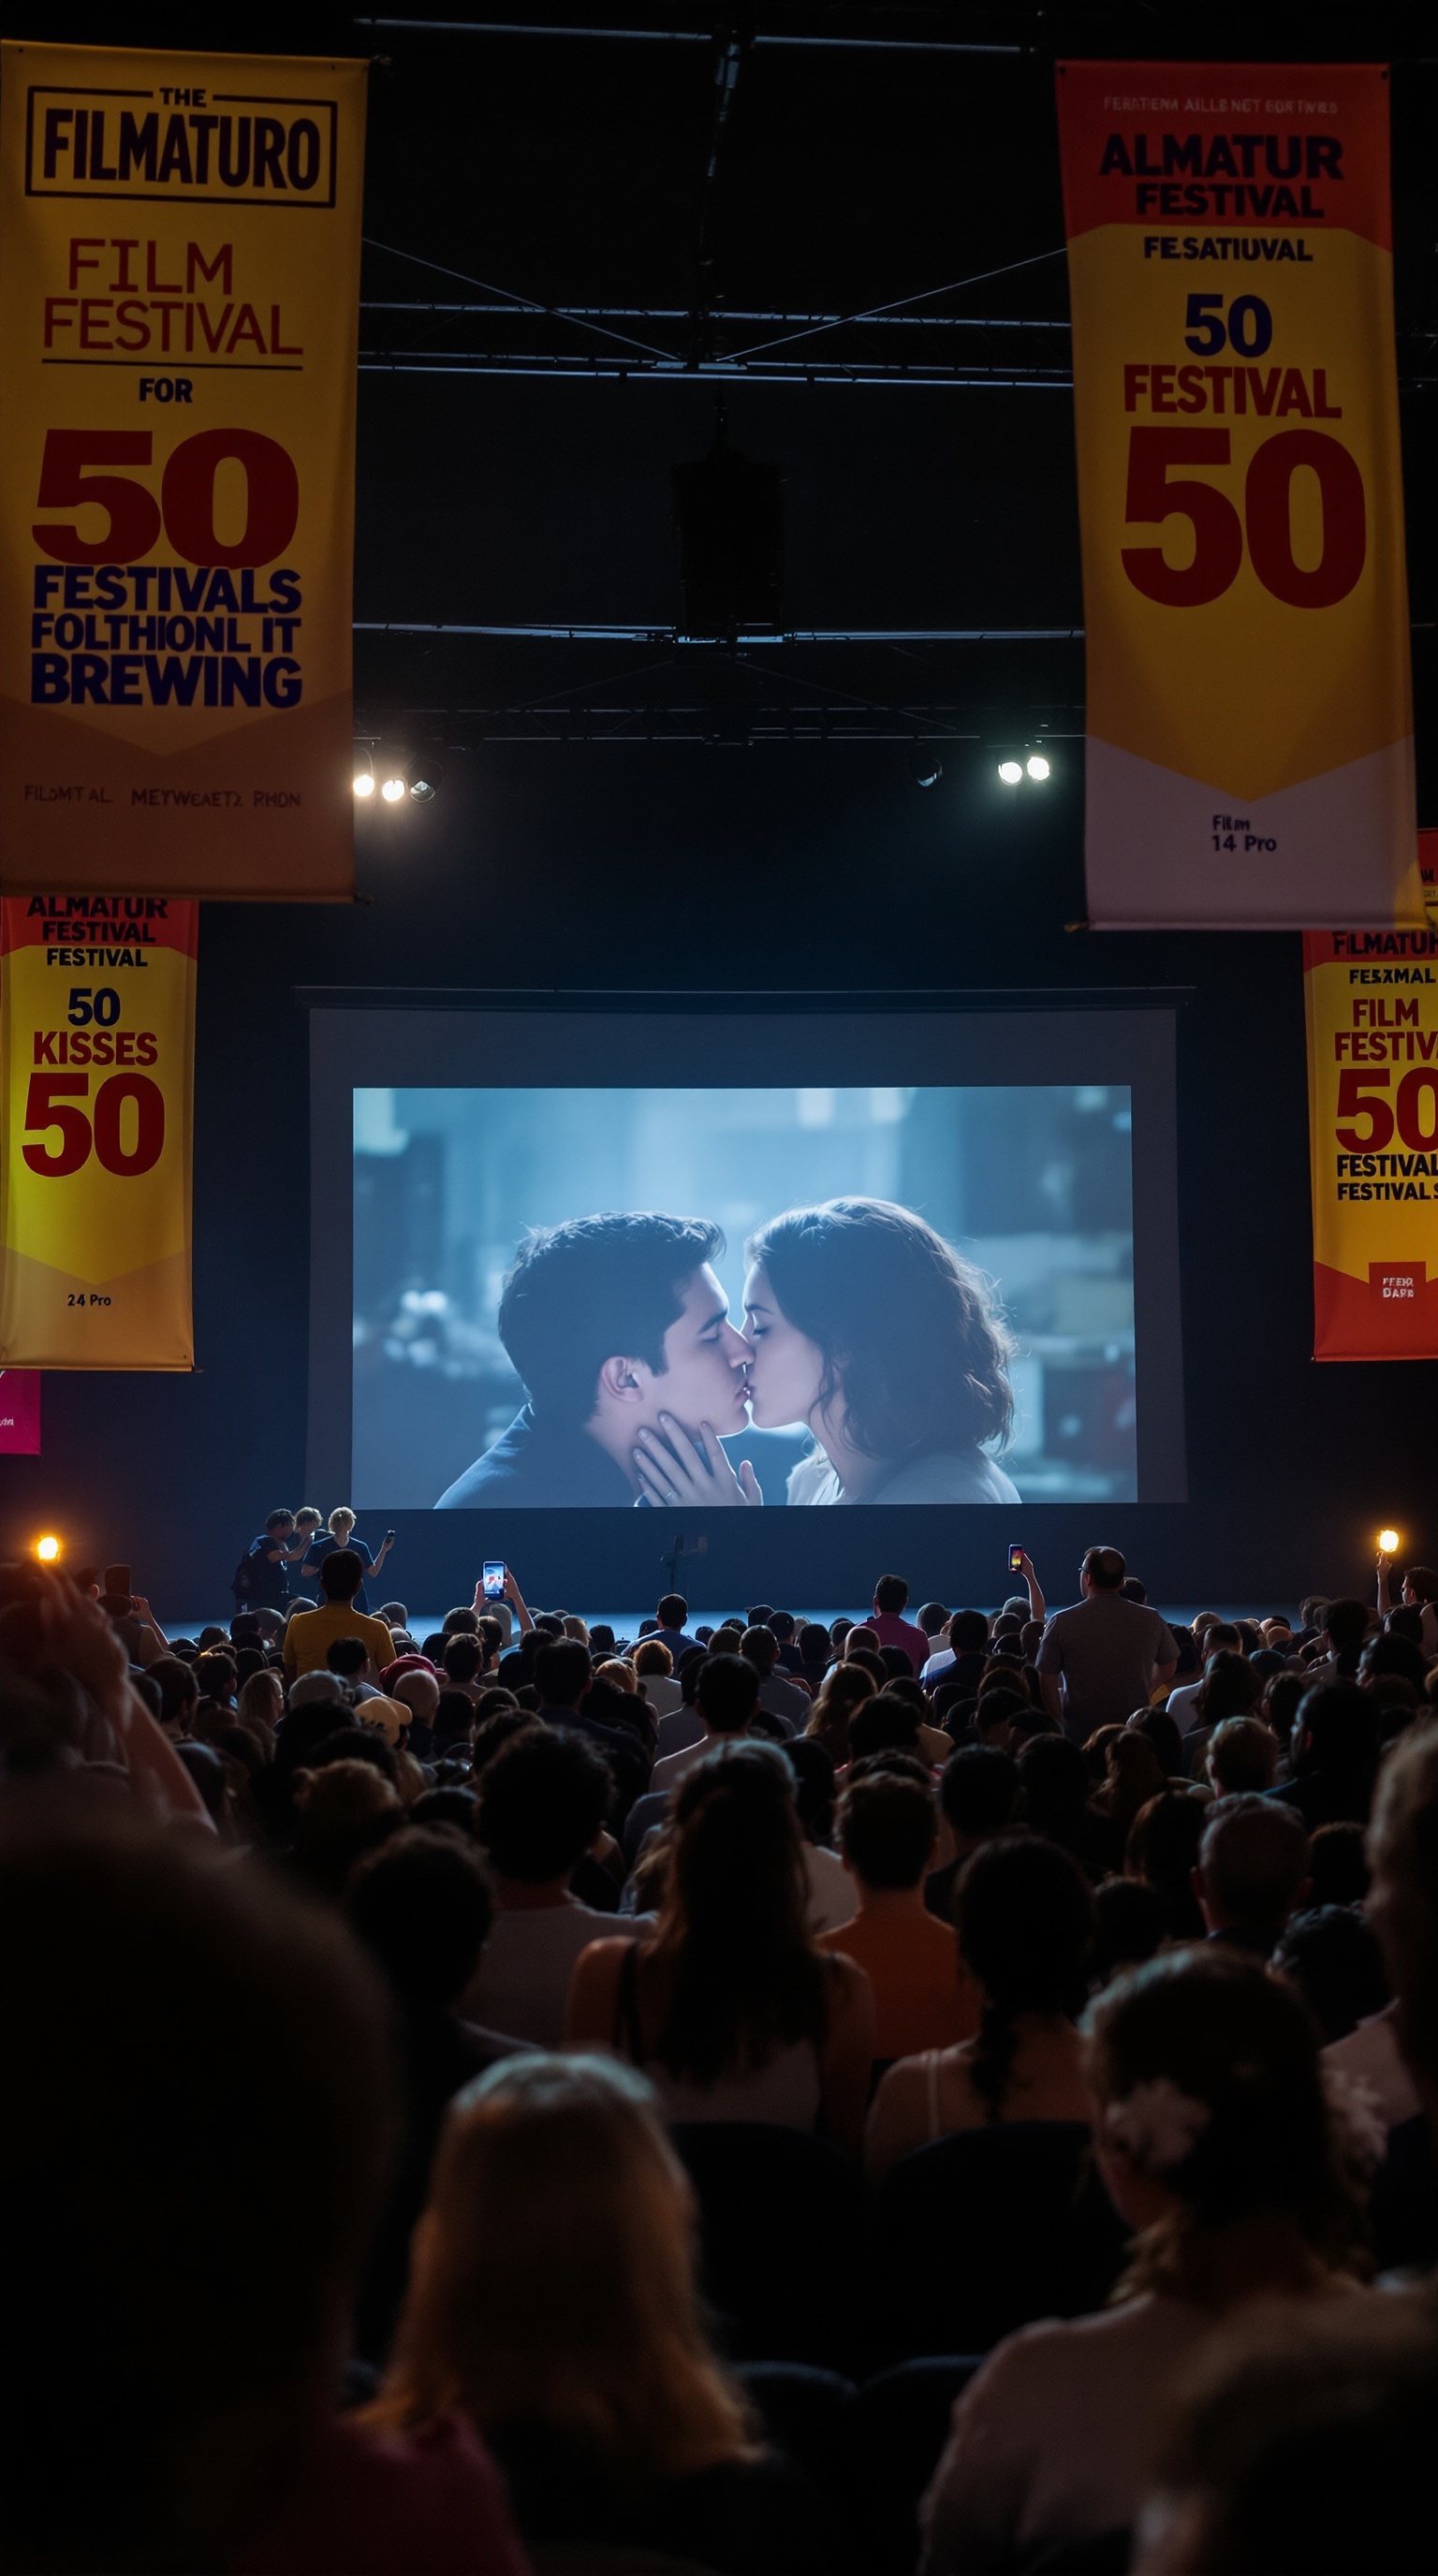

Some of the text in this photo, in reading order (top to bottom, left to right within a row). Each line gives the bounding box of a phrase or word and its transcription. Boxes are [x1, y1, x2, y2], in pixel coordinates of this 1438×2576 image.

[159, 87, 207, 109] THE
[43, 108, 320, 191] FILMATURO
[1100, 134, 1344, 179] ALMATUR
[1136, 183, 1325, 217] FESTIVAL
[69, 238, 233, 295] FILM
[1144, 236, 1313, 261] FESATIUVAL
[44, 297, 303, 355] FESTIVAL
[1184, 293, 1273, 358] 50
[139, 377, 193, 402] FOR
[1123, 364, 1343, 418] FESTIVAL
[32, 429, 299, 569] 50
[1121, 426, 1366, 608] 50
[35, 565, 301, 613] FESTIVALS
[262, 618, 301, 652] IT
[31, 653, 301, 709] BREWING
[1212, 834, 1277, 852] 14 Pro
[27, 896, 169, 919] ALMATUR
[42, 921, 155, 943] FESTIVAL
[47, 948, 148, 967] FESTIVAL
[67, 988, 121, 1027] 50
[1353, 998, 1419, 1027] FILM
[34, 1032, 158, 1066] KISSES
[1335, 1032, 1438, 1061] FESTIV
[22, 1072, 165, 1178] 50
[1335, 1067, 1438, 1153] 50
[67, 1294, 111, 1307] 24 Pro
